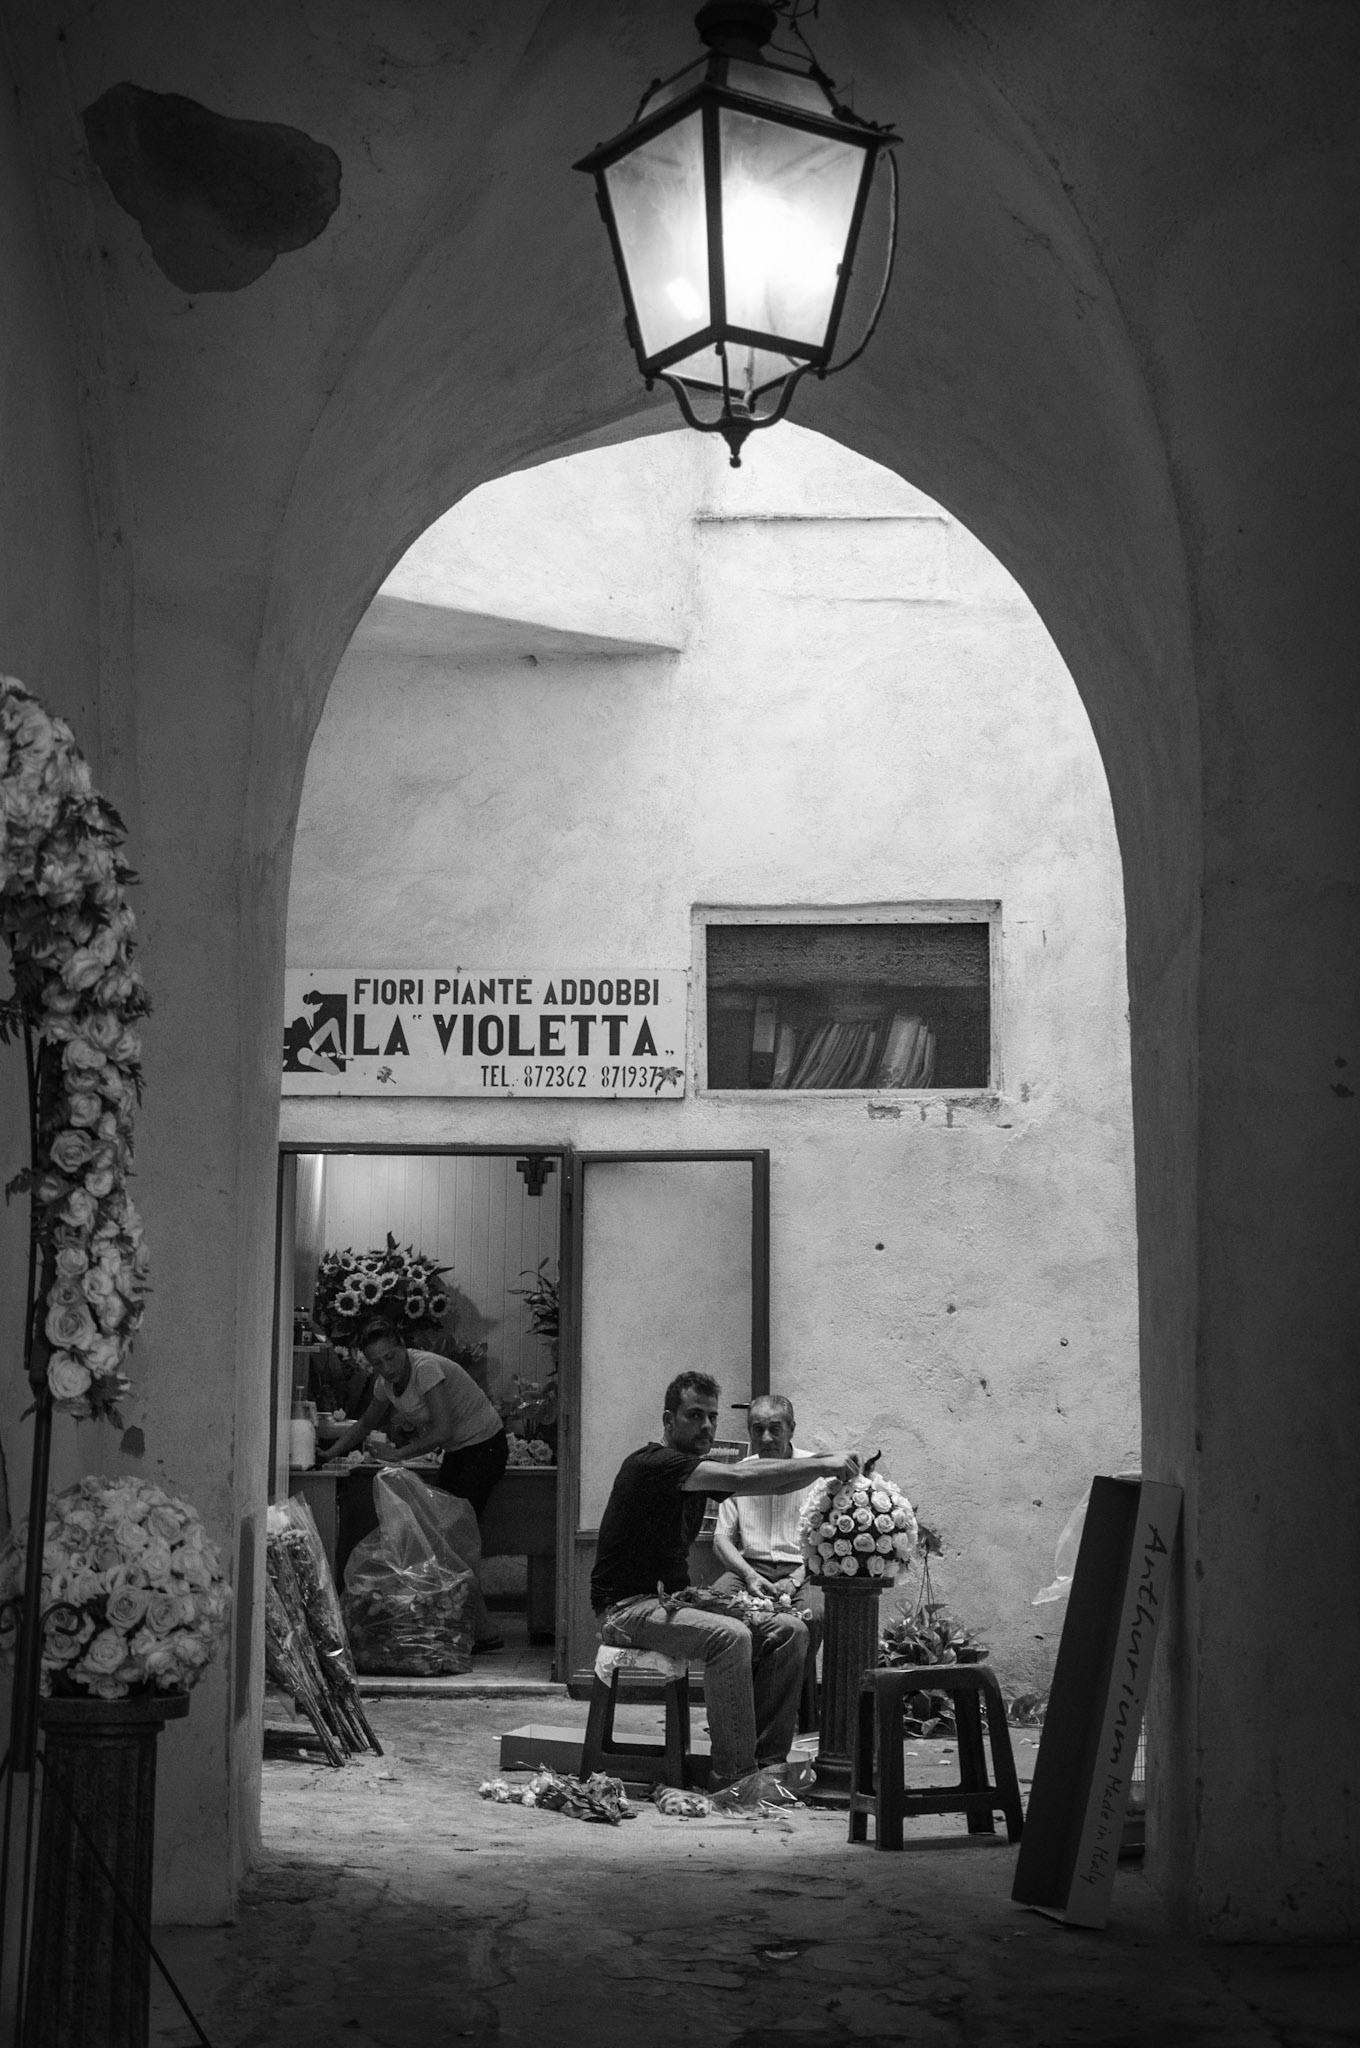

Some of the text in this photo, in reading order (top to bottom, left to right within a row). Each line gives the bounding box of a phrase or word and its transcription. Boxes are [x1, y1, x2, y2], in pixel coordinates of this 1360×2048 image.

[354, 978, 659, 1006] FIORI PIANTE ADDOBBI
[353, 1014, 410, 1056] LA
[524, 1065, 587, 1088] 872362
[601, 1065, 659, 1088] 871937
[1101, 1774, 1123, 1820] Made
[1096, 1824, 1113, 1841] in
[1079, 1846, 1110, 1886] Italy
